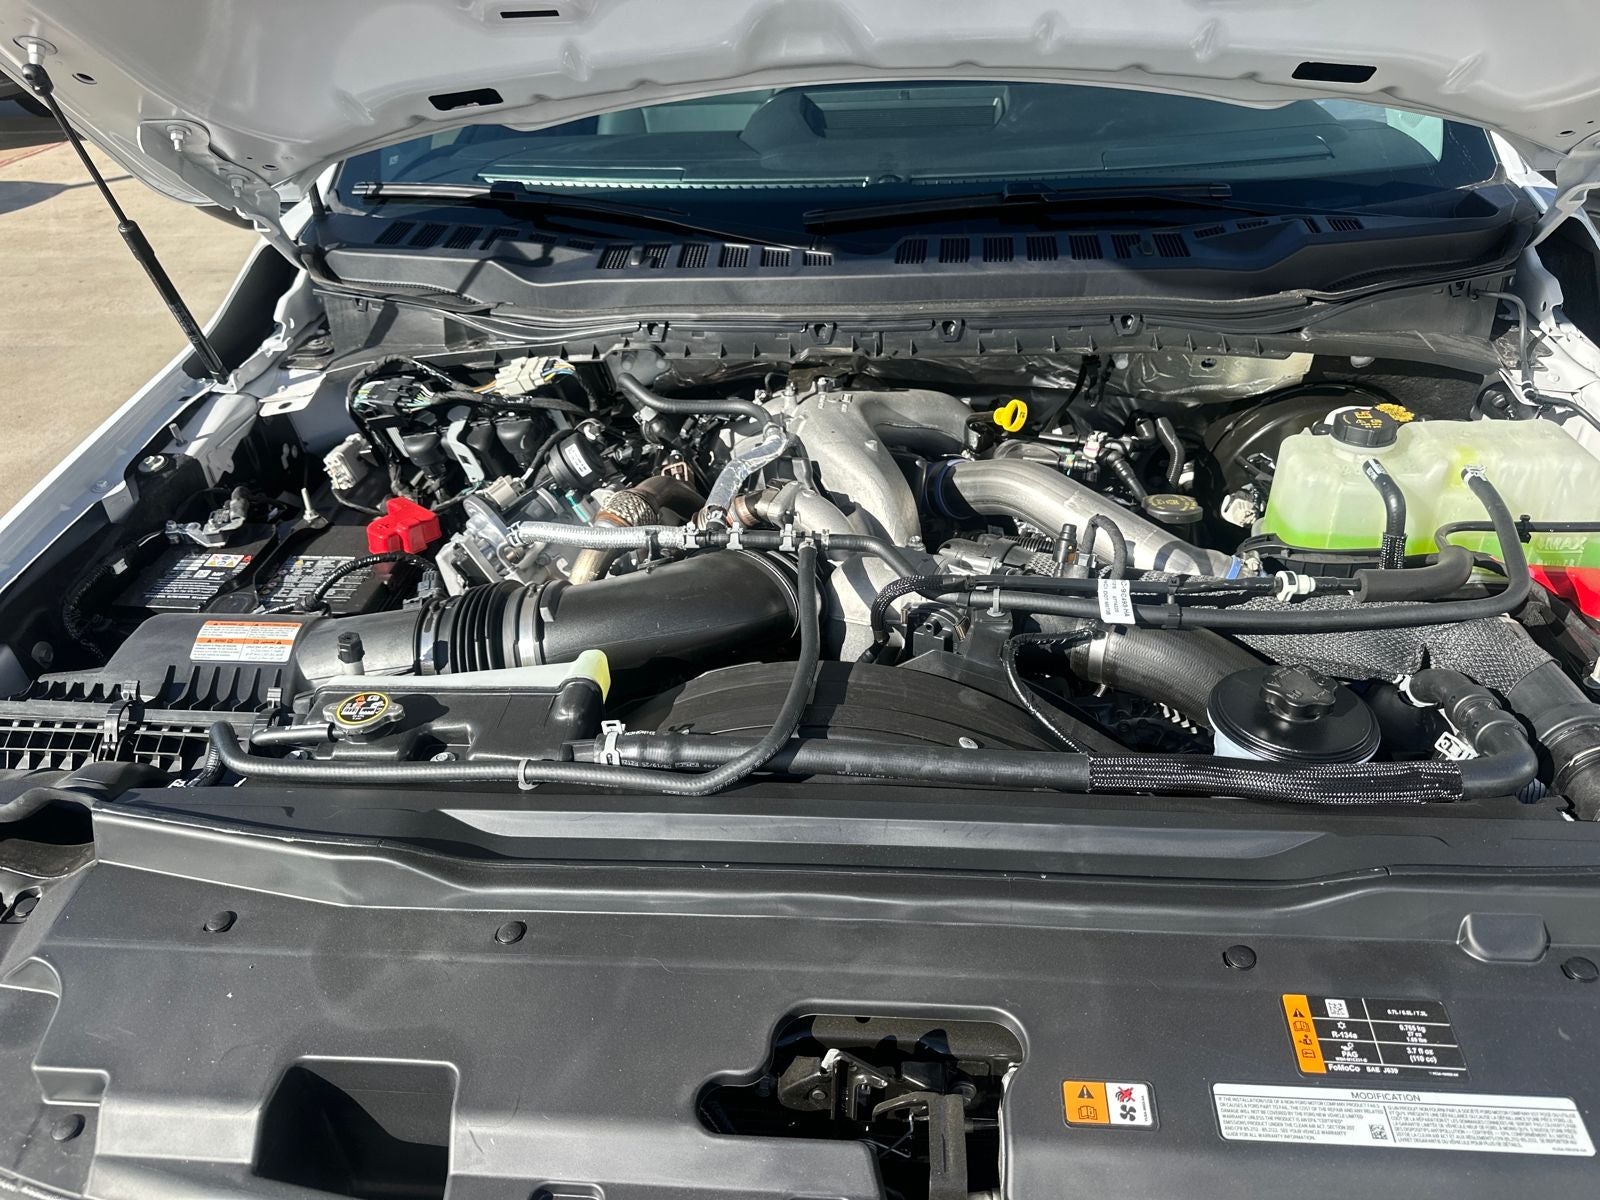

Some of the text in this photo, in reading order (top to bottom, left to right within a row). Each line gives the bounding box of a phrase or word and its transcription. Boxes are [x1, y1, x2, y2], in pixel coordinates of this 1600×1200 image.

[1417, 1025, 1426, 1034] kg
[1331, 1030, 1358, 1039] R-134a
[1328, 1063, 1361, 1072] FoMoCo
[1351, 1092, 1421, 1101] MODIFICATION
